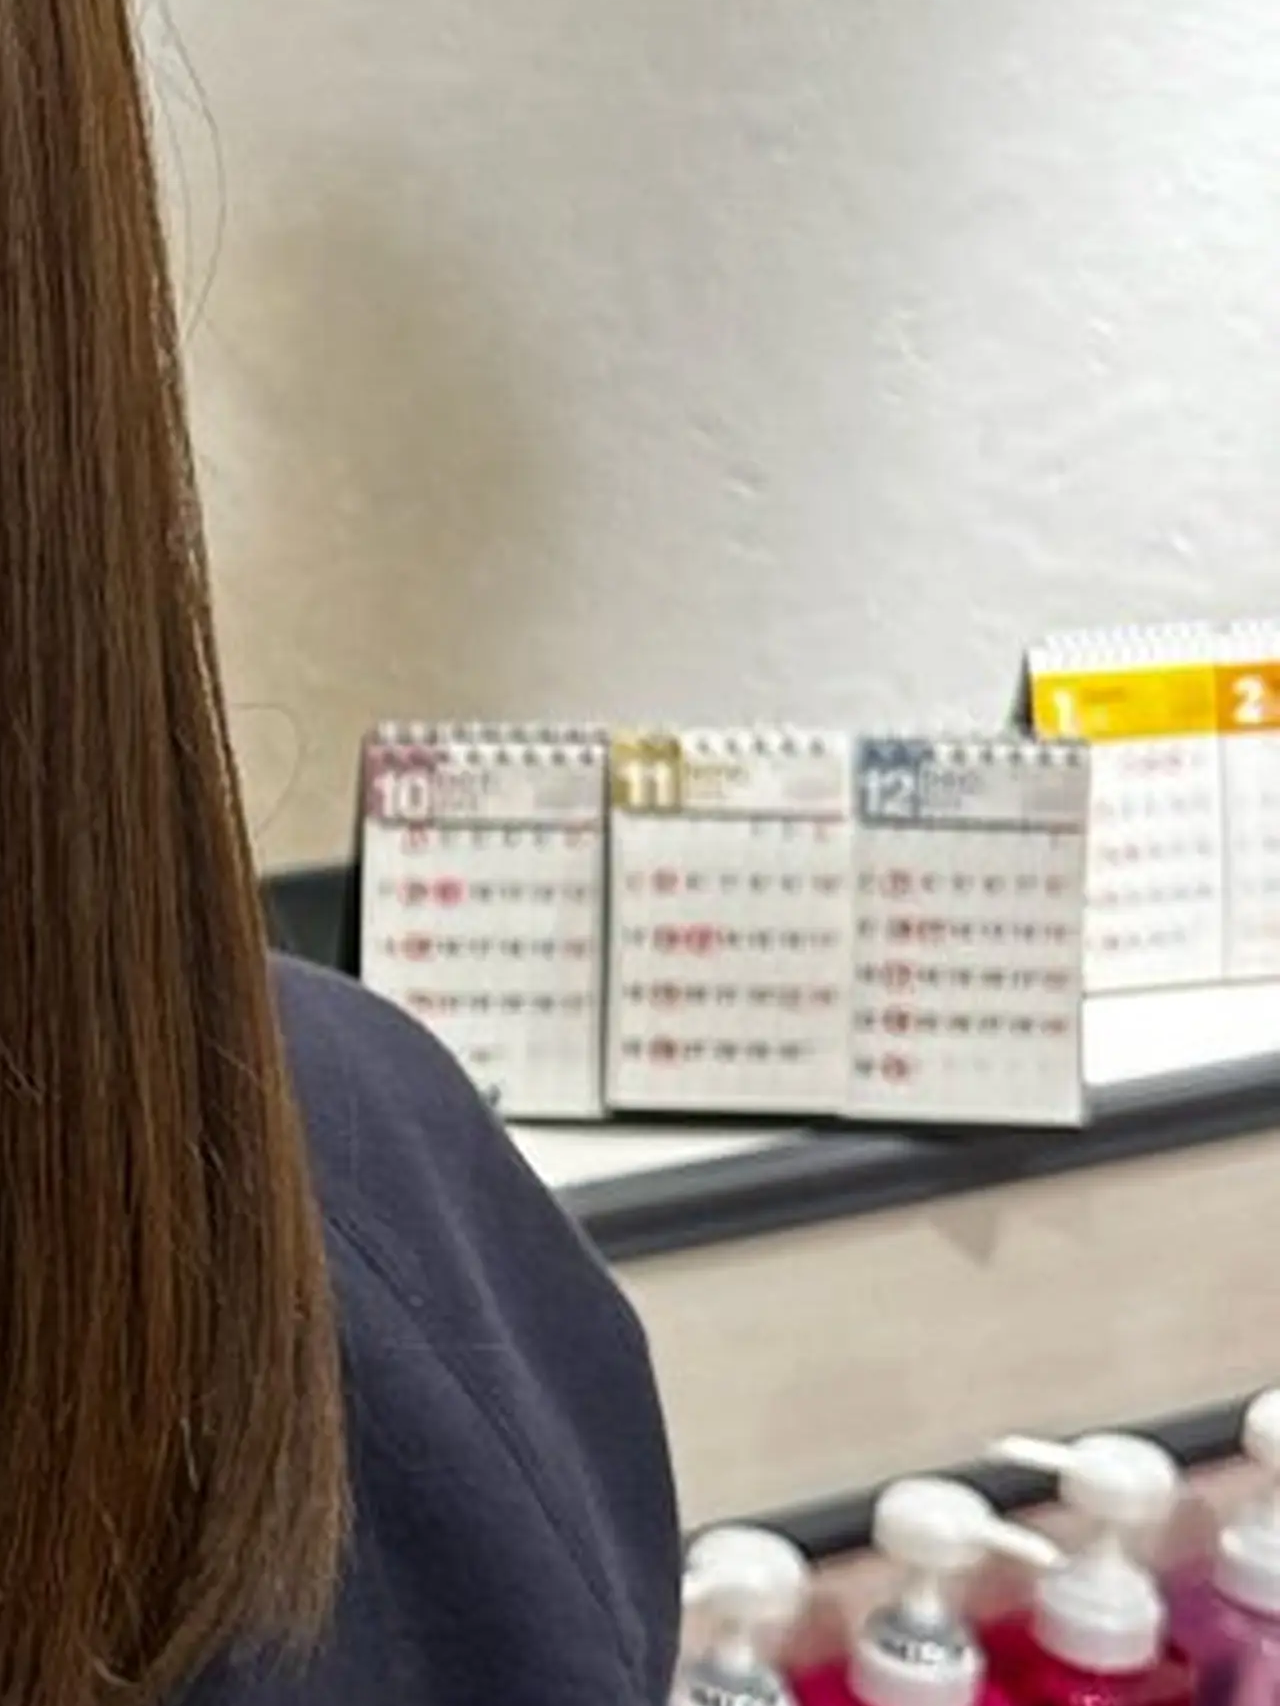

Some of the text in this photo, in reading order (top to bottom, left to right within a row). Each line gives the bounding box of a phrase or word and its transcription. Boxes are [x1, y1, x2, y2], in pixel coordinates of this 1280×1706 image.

[1053, 691, 1079, 734] 1
[1233, 675, 1265, 724] 2
[374, 770, 428, 819] 10
[620, 759, 672, 807] 11
[865, 769, 914, 814] 12
